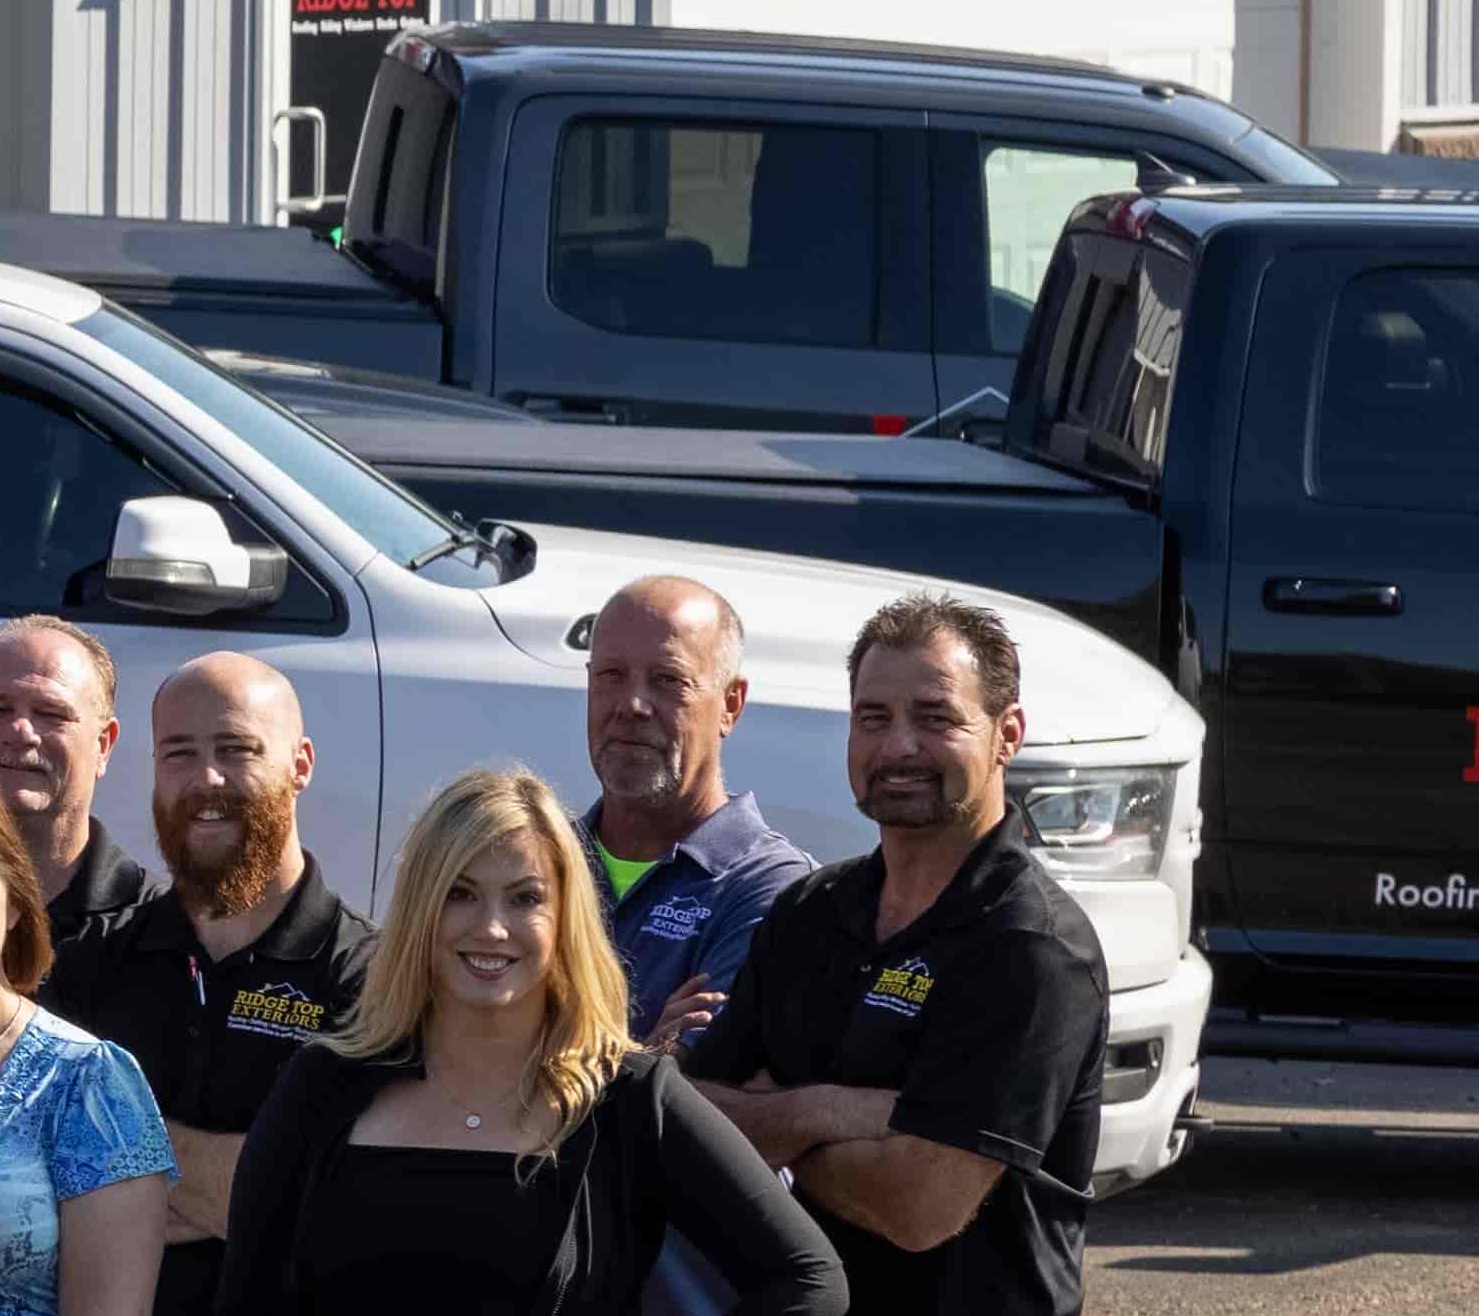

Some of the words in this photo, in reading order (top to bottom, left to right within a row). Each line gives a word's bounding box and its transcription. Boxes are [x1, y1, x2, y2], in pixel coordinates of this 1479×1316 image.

[232, 1003, 322, 1030] EXTERIORS
[234, 989, 290, 1013] RIDGE
[291, 1000, 325, 1018] TOP
